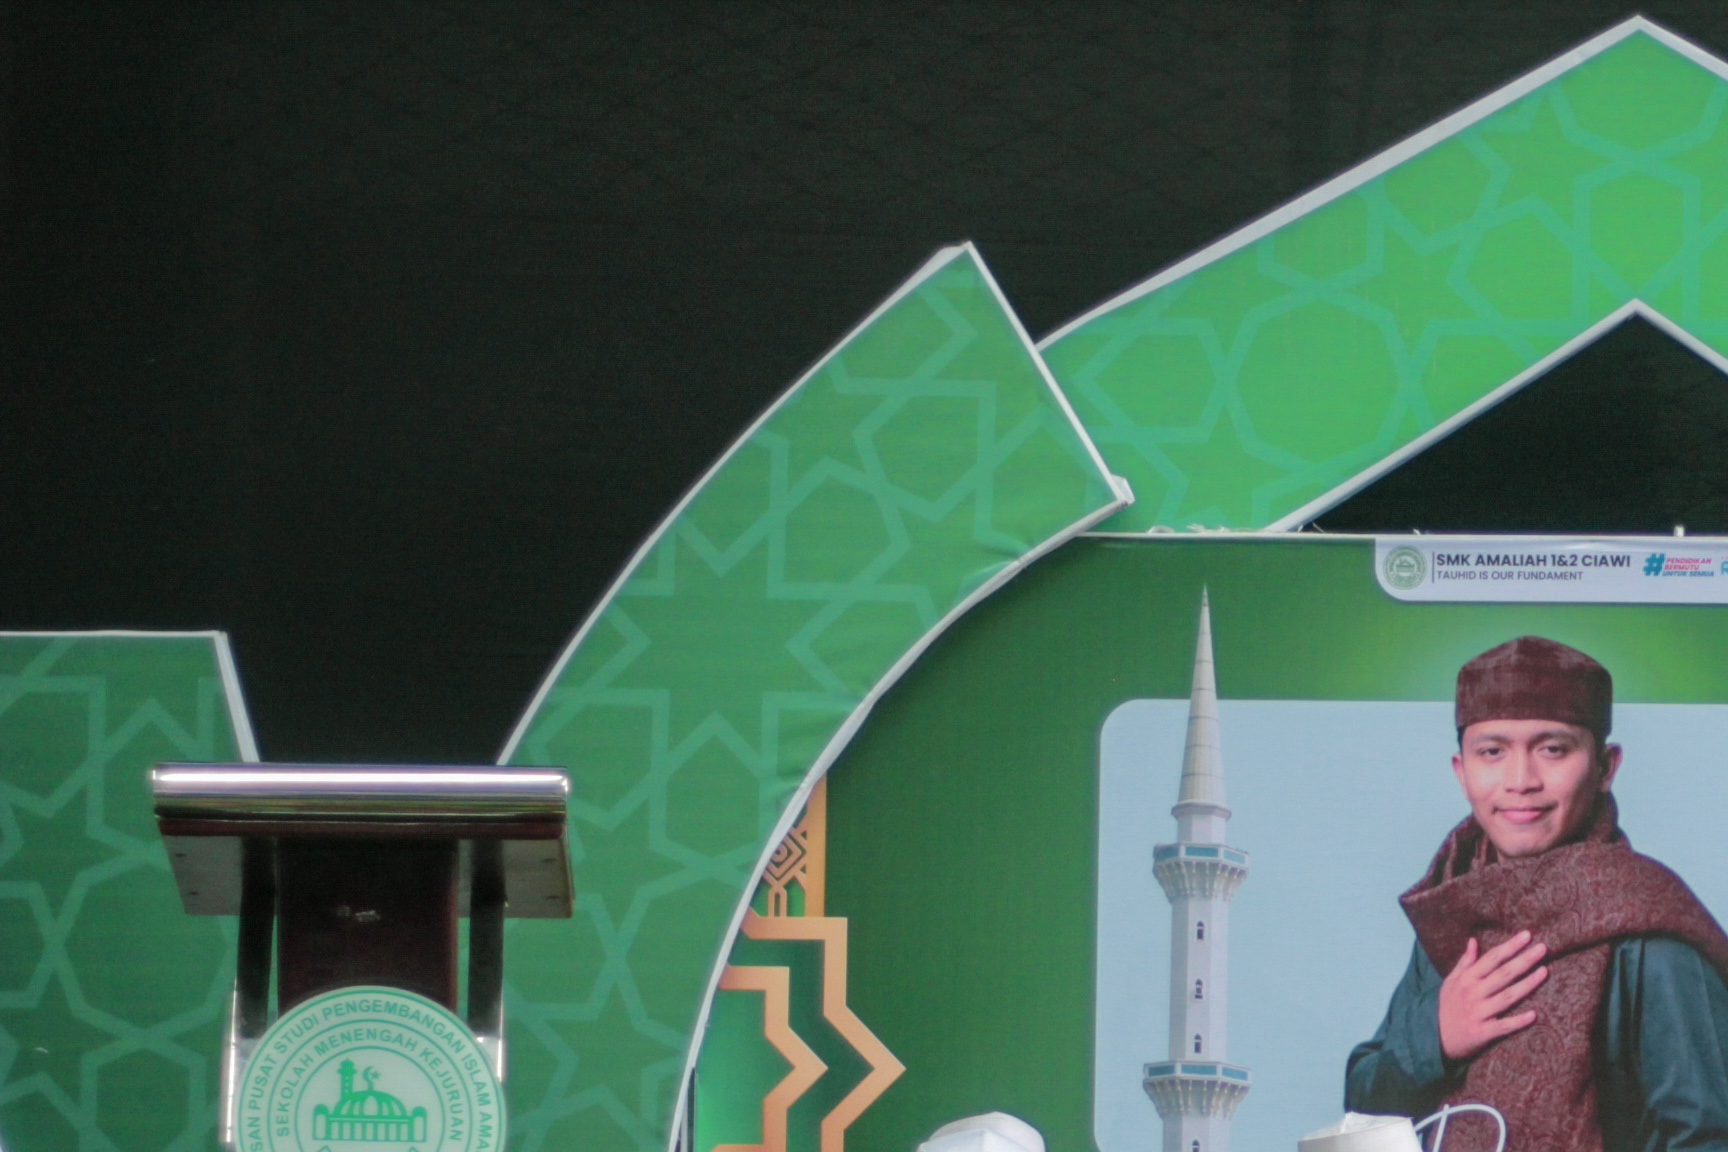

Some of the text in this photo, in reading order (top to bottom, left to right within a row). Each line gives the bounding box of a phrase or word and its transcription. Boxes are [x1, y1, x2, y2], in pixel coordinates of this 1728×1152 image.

[1436, 553, 1631, 567] SMK AMALIAH 1&2 CIAWI
[1437, 570, 1584, 581] TAUHID IS OUR FUNDAMENT
[249, 1055, 278, 1111] PUSAT
[273, 1013, 319, 1054] STUDI
[322, 999, 466, 1054] PENGEMBANGAN
[460, 1052, 491, 1107] ISLAM
[276, 1027, 464, 1142] SEKOLAH MENENGAH KEJURUAN
